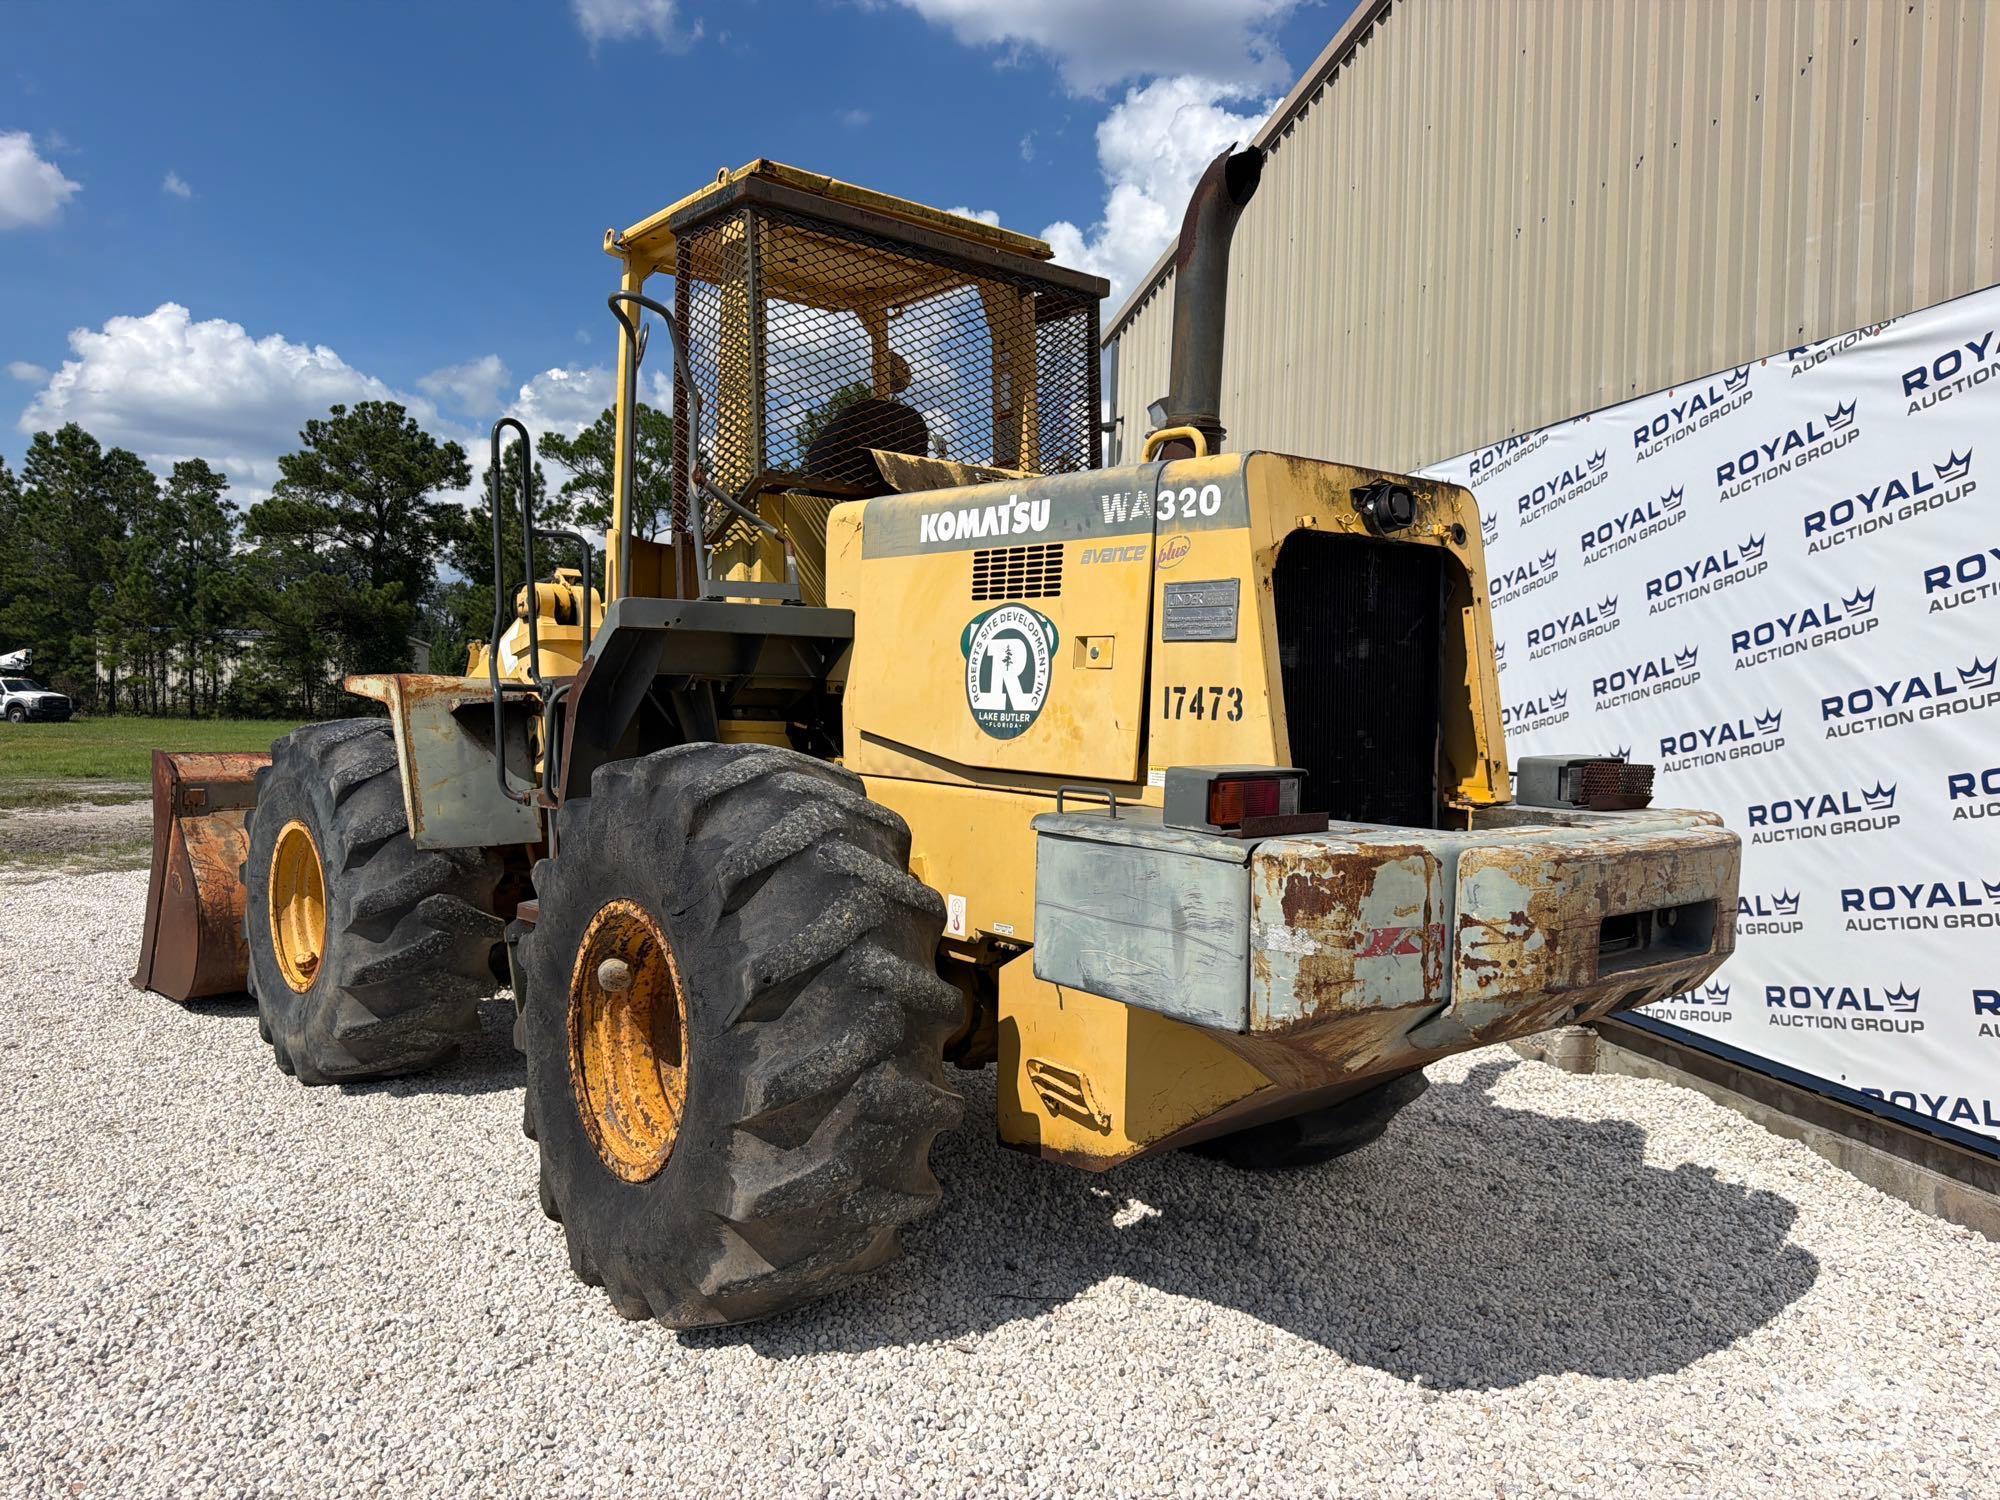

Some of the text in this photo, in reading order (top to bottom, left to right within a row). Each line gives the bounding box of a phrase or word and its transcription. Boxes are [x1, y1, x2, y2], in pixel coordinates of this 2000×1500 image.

[1791, 325, 1874, 378] AUCTION
[1902, 330, 2000, 398] ROY
[1633, 386, 1724, 449] ROYAL
[1636, 390, 1753, 463] AUCTION GROUP
[1471, 434, 1549, 490] AUCTION GROUP
[1716, 421, 1825, 487] ROYAL
[1719, 428, 1860, 503] AUCTION GROUP
[1518, 464, 1587, 514] ROYAL
[1520, 471, 1608, 527] AUCTION GROUP
[1804, 470, 1934, 538] ROYAL
[920, 494, 1050, 543] KOMATSU
[1581, 501, 1661, 552] ROYAL
[1583, 510, 1687, 567] AUCTION GROUP
[1807, 480, 1977, 555] AUCTION GROUP
[1080, 545, 1147, 565] avance
[1155, 540, 1187, 571] plus
[1646, 549, 1738, 601] ROYAL
[1489, 561, 1539, 596] OYAL
[1491, 570, 1559, 609] CTION GROUP
[1649, 560, 1768, 616] AUCTION GROUP
[1928, 582, 2000, 614] AUCTI
[1527, 606, 1598, 648] ROYAL
[1529, 618, 1620, 661] AUCTION GROUP
[1731, 602, 1842, 654] ROYAL
[1734, 617, 1879, 670] AUCTION GROUP
[970, 641, 983, 703] ROBERTS
[980, 618, 998, 640] SITE
[980, 638, 1036, 710] R
[1592, 657, 1675, 698] ROYAL
[1163, 686, 1243, 722] 17473
[1501, 697, 1549, 725] OYAL
[1595, 671, 1701, 712] AUCTION GROUP
[1821, 671, 1957, 721] ROYAL
[978, 712, 1030, 722] LAKE BUTLER
[1504, 711, 1569, 737] TION GROUP
[1825, 691, 2000, 740] AUCTION GROUP
[1660, 719, 1755, 757] ROYAL
[1663, 738, 1785, 773] AUCTION GROUP
[1747, 791, 1862, 827] ROYAL
[1751, 814, 1901, 845] AUCTION GROUP
[1841, 881, 1982, 912] ROYAL
[1745, 921, 1804, 935] GROUP
[1845, 913, 2000, 931] AUCTION GRO
[1680, 1010, 1732, 1023] GROUP
[1765, 985, 1884, 1012] ROYAL
[1768, 1013, 1925, 1034] AUCTION GROUP
